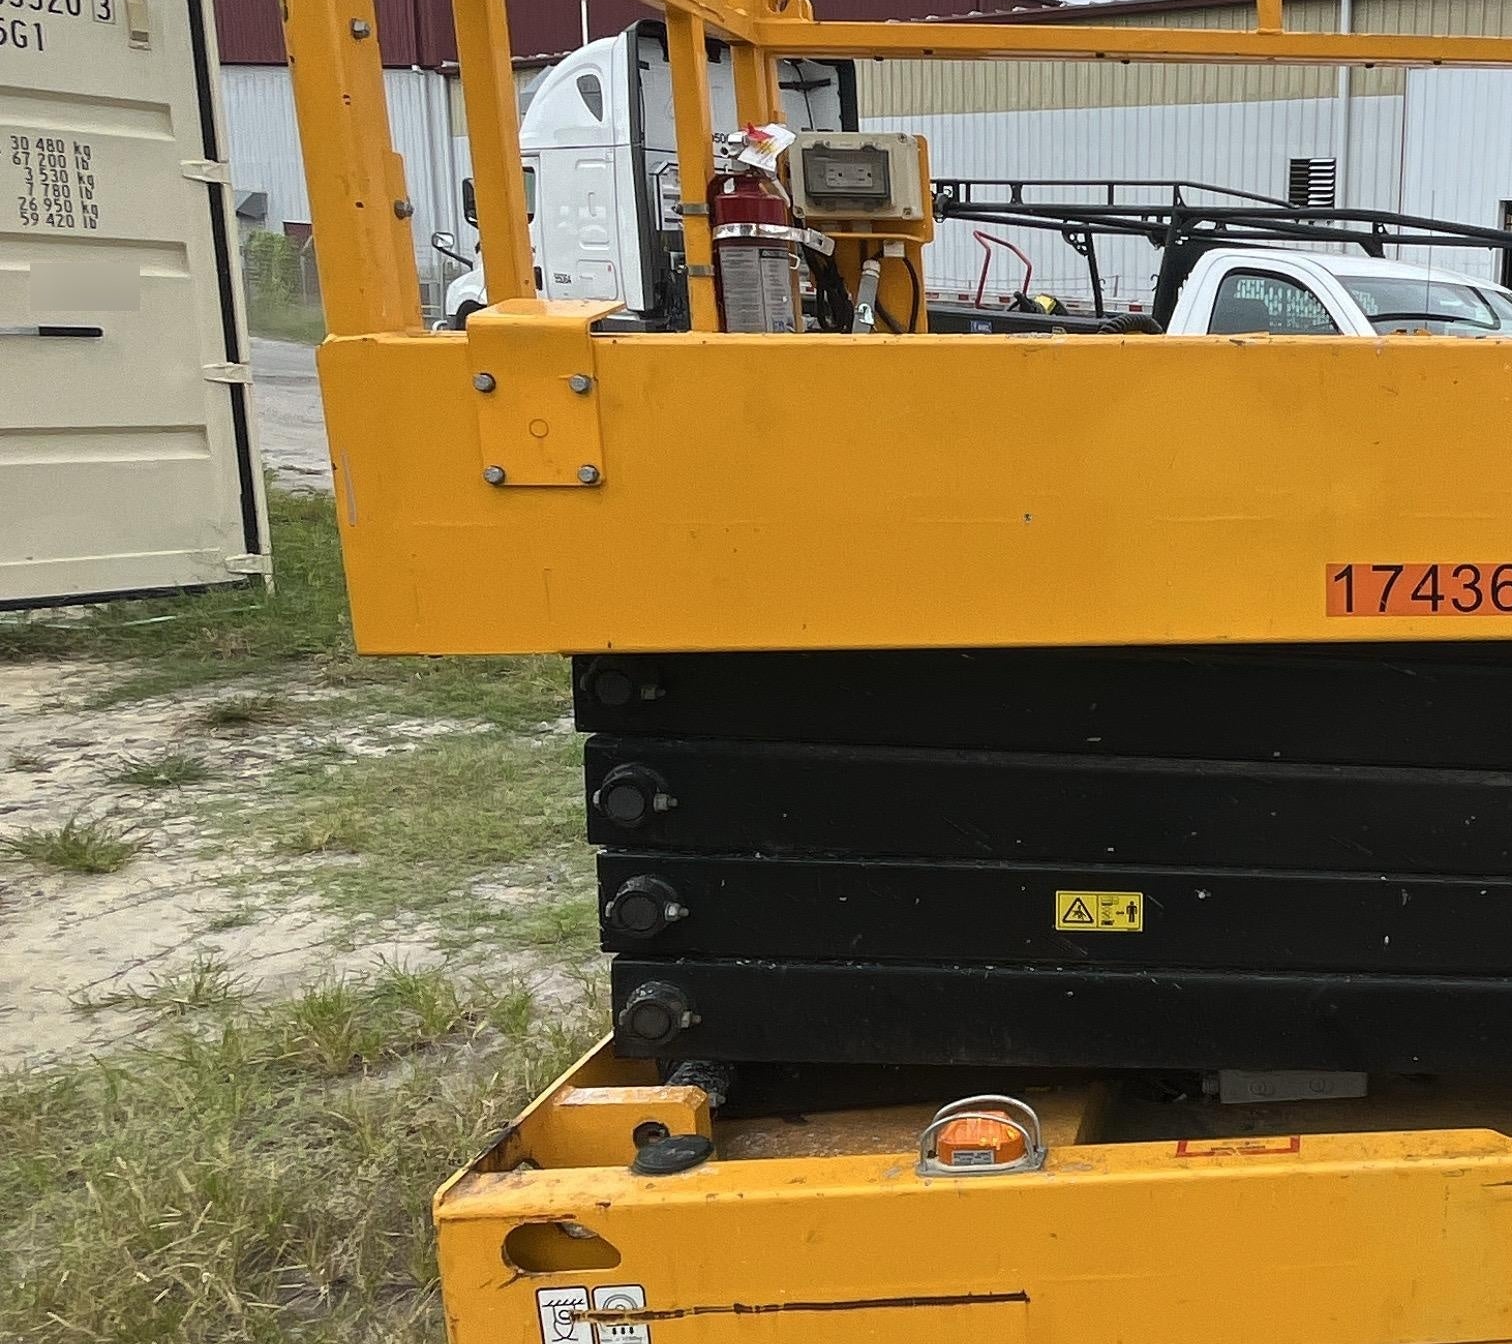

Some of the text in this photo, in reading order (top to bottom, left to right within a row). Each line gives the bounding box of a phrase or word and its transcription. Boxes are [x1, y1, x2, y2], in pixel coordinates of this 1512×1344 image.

[10, 135, 91, 160] 30 480 kg
[12, 151, 89, 170] 67 200 lb
[24, 166, 95, 190] 3 530 kg
[25, 181, 93, 200] 7 780 lb
[18, 196, 99, 219] 26 950 kg
[20, 211, 97, 229] 59 420 lb
